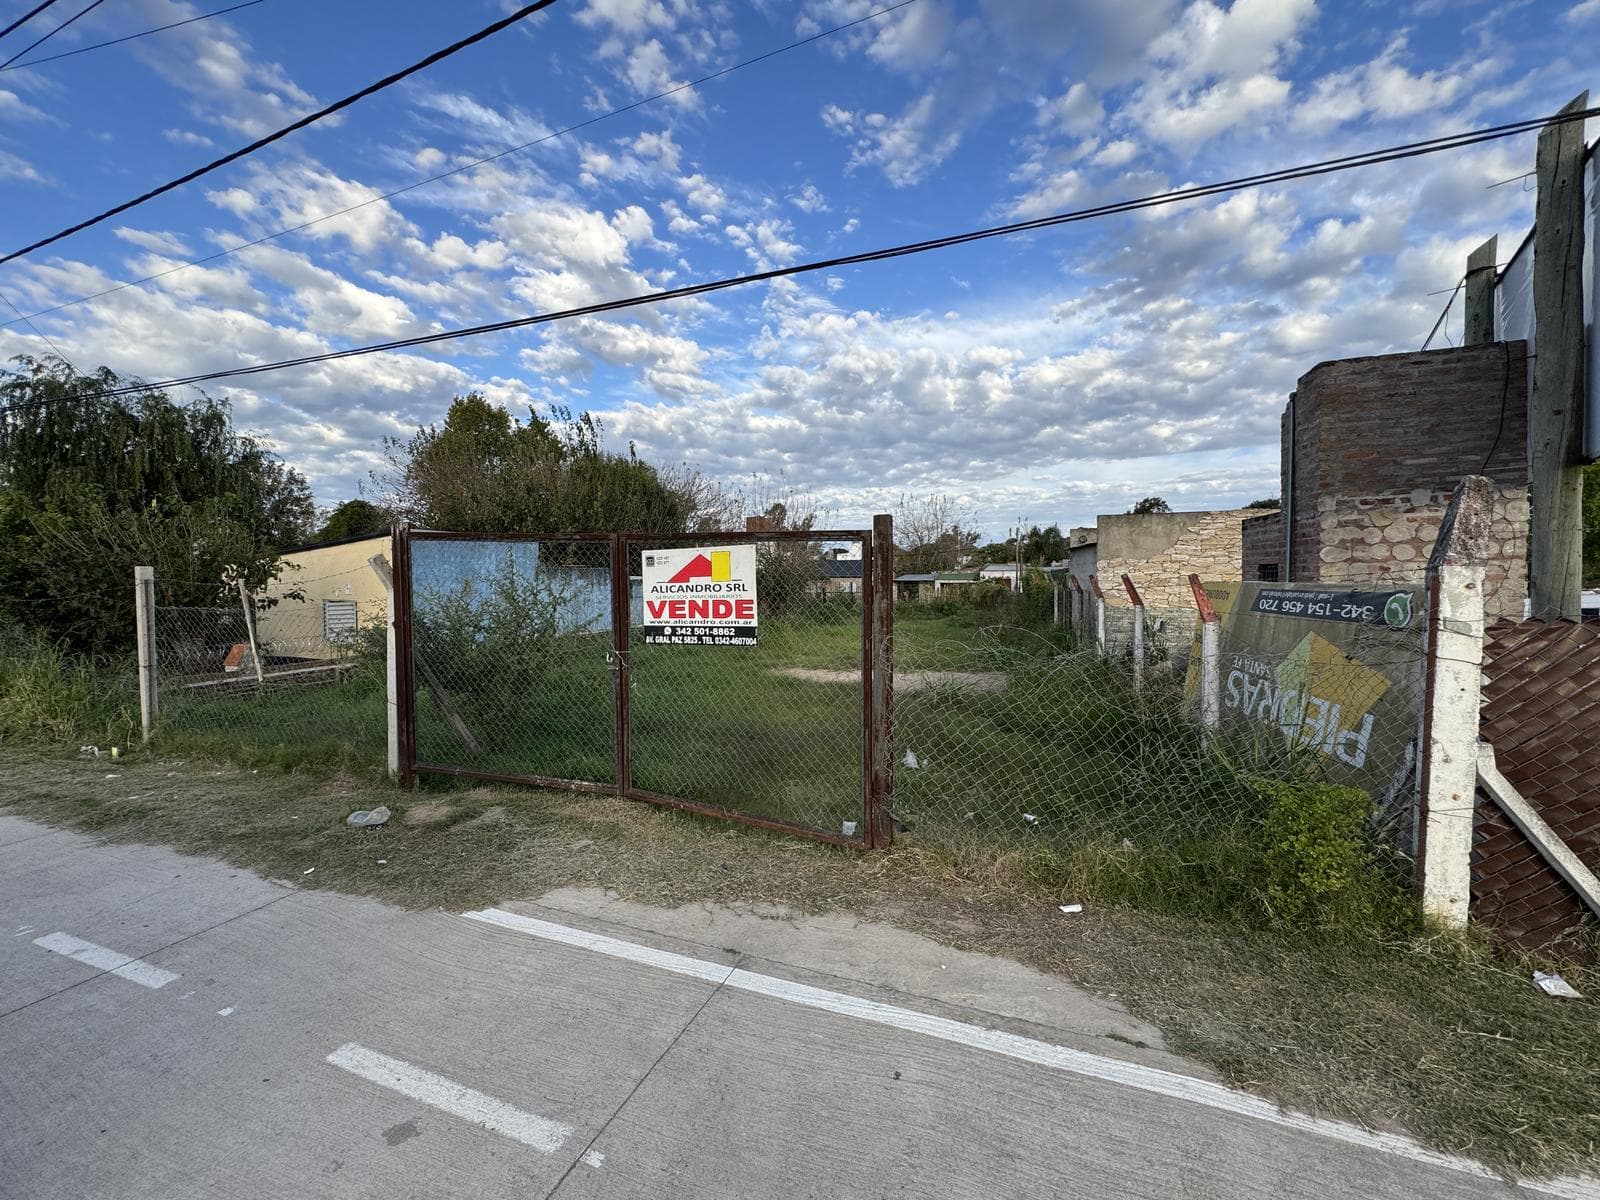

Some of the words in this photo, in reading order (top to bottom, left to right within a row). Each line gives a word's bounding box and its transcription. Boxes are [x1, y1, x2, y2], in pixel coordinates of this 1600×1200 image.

[651, 584, 722, 593] ALICANDRO
[726, 583, 748, 592] SRL
[646, 599, 754, 619] VENDE
[1260, 599, 1278, 611] 720
[1281, 600, 1304, 613] 456
[1307, 602, 1374, 619] 342-154
[675, 627, 692, 635] 342
[694, 627, 735, 635] 501-8862
[1232, 655, 1242, 669] FE
[1225, 670, 1375, 769] PIEDRAS
